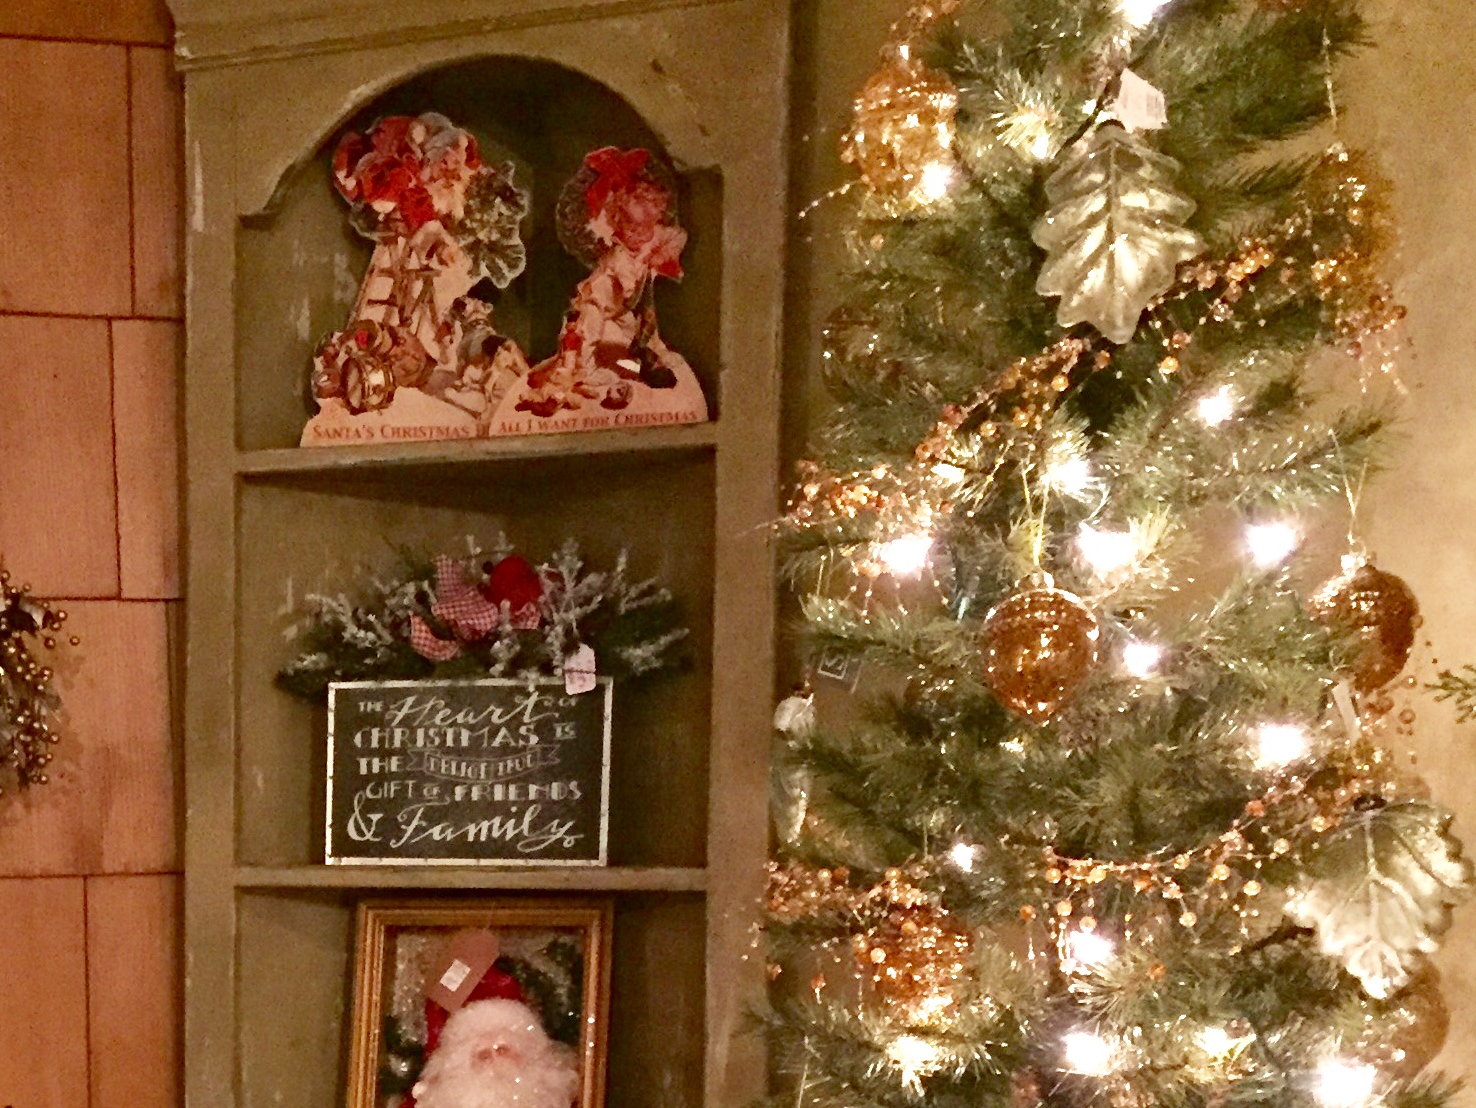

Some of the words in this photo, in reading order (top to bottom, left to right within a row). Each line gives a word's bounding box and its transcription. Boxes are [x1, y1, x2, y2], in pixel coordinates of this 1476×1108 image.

[312, 424, 375, 440] SANTA'S
[380, 423, 470, 440] CHRISTMAS
[500, 421, 522, 434] ALL
[537, 417, 578, 431] WANT
[582, 415, 611, 429] FOR
[613, 410, 698, 427] CHRISTMAS
[358, 700, 384, 713] THE
[385, 690, 560, 726] Heart
[353, 723, 540, 749] CHRISTMAS
[554, 722, 577, 740] IS
[357, 755, 404, 776] THE
[365, 779, 417, 800] GIFT
[454, 779, 583, 802] FRIENDS
[347, 789, 384, 842] &
[389, 803, 585, 853] Family
